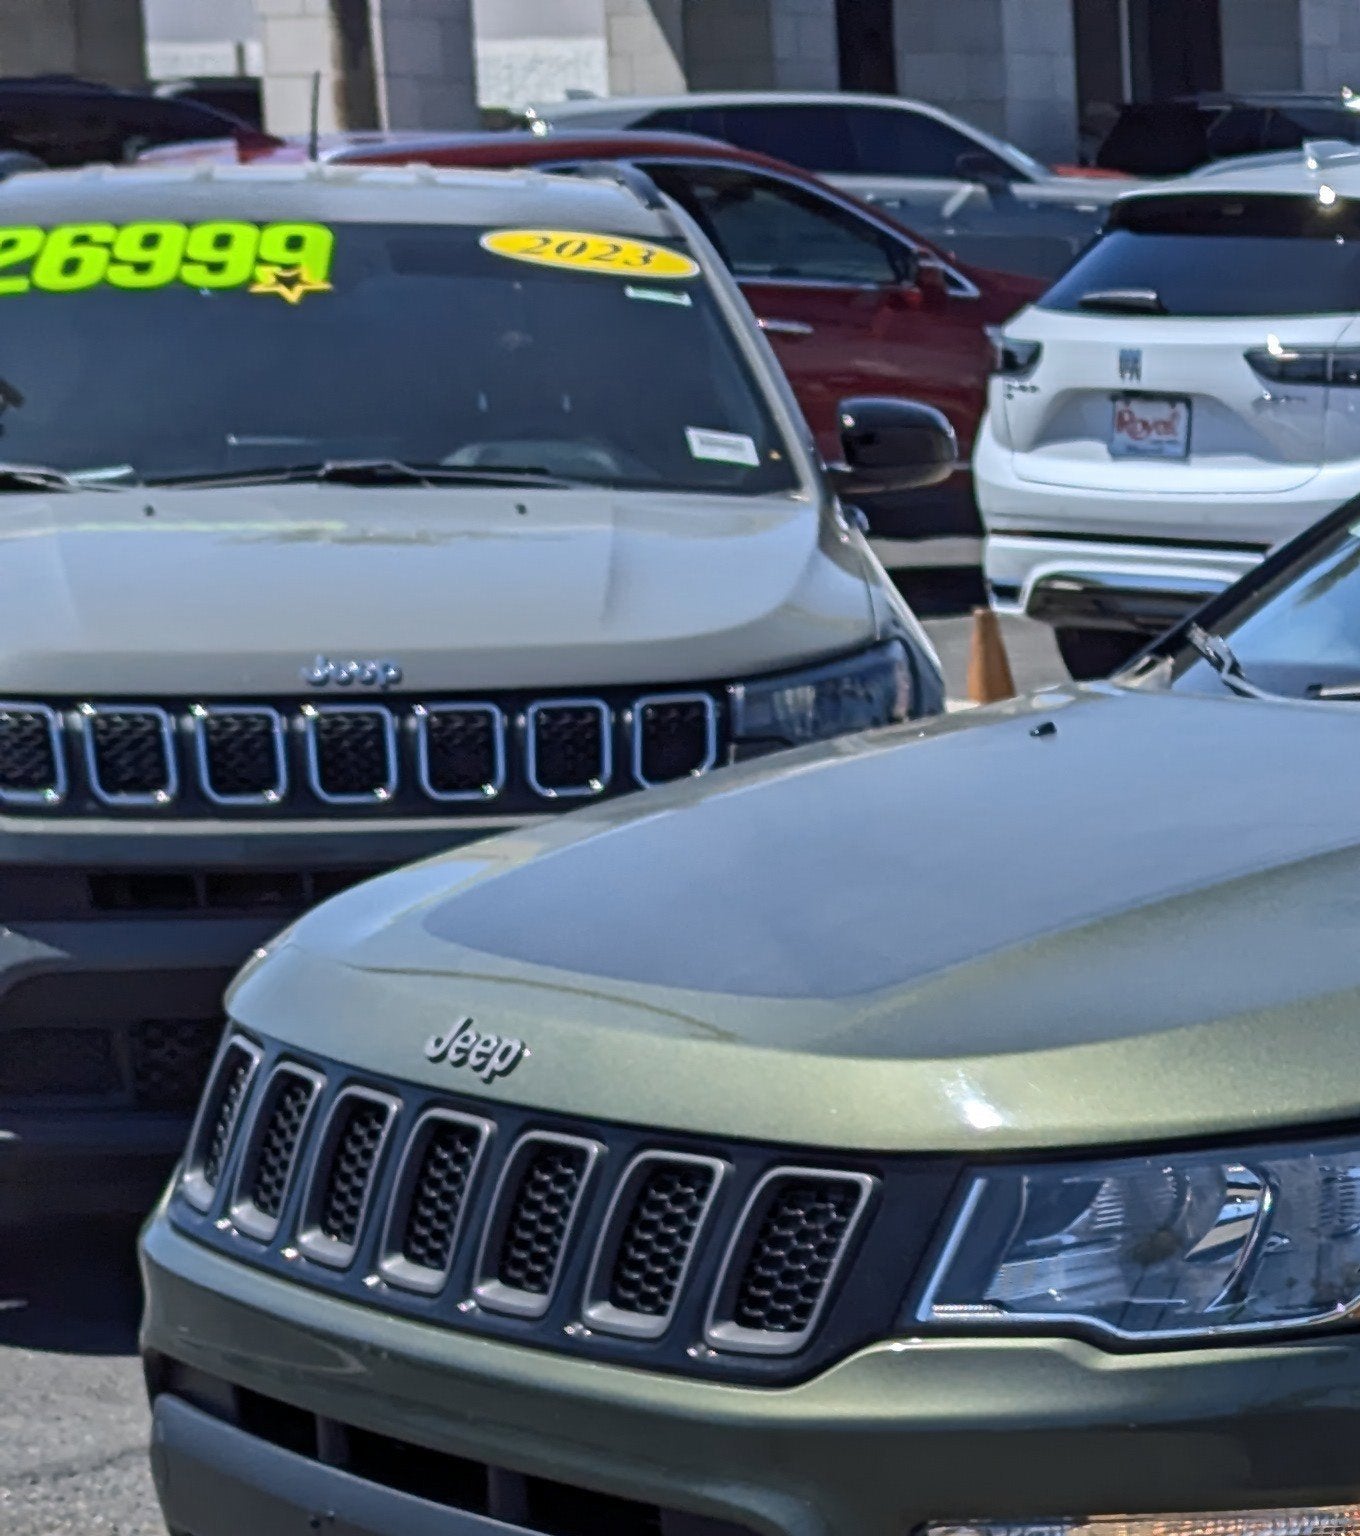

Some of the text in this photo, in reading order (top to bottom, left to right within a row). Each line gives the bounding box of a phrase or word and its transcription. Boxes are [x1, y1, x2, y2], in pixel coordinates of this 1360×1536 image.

[516, 236, 656, 266] 2023
[299, 654, 403, 691] Jeep
[424, 1015, 526, 1084] Jeep
